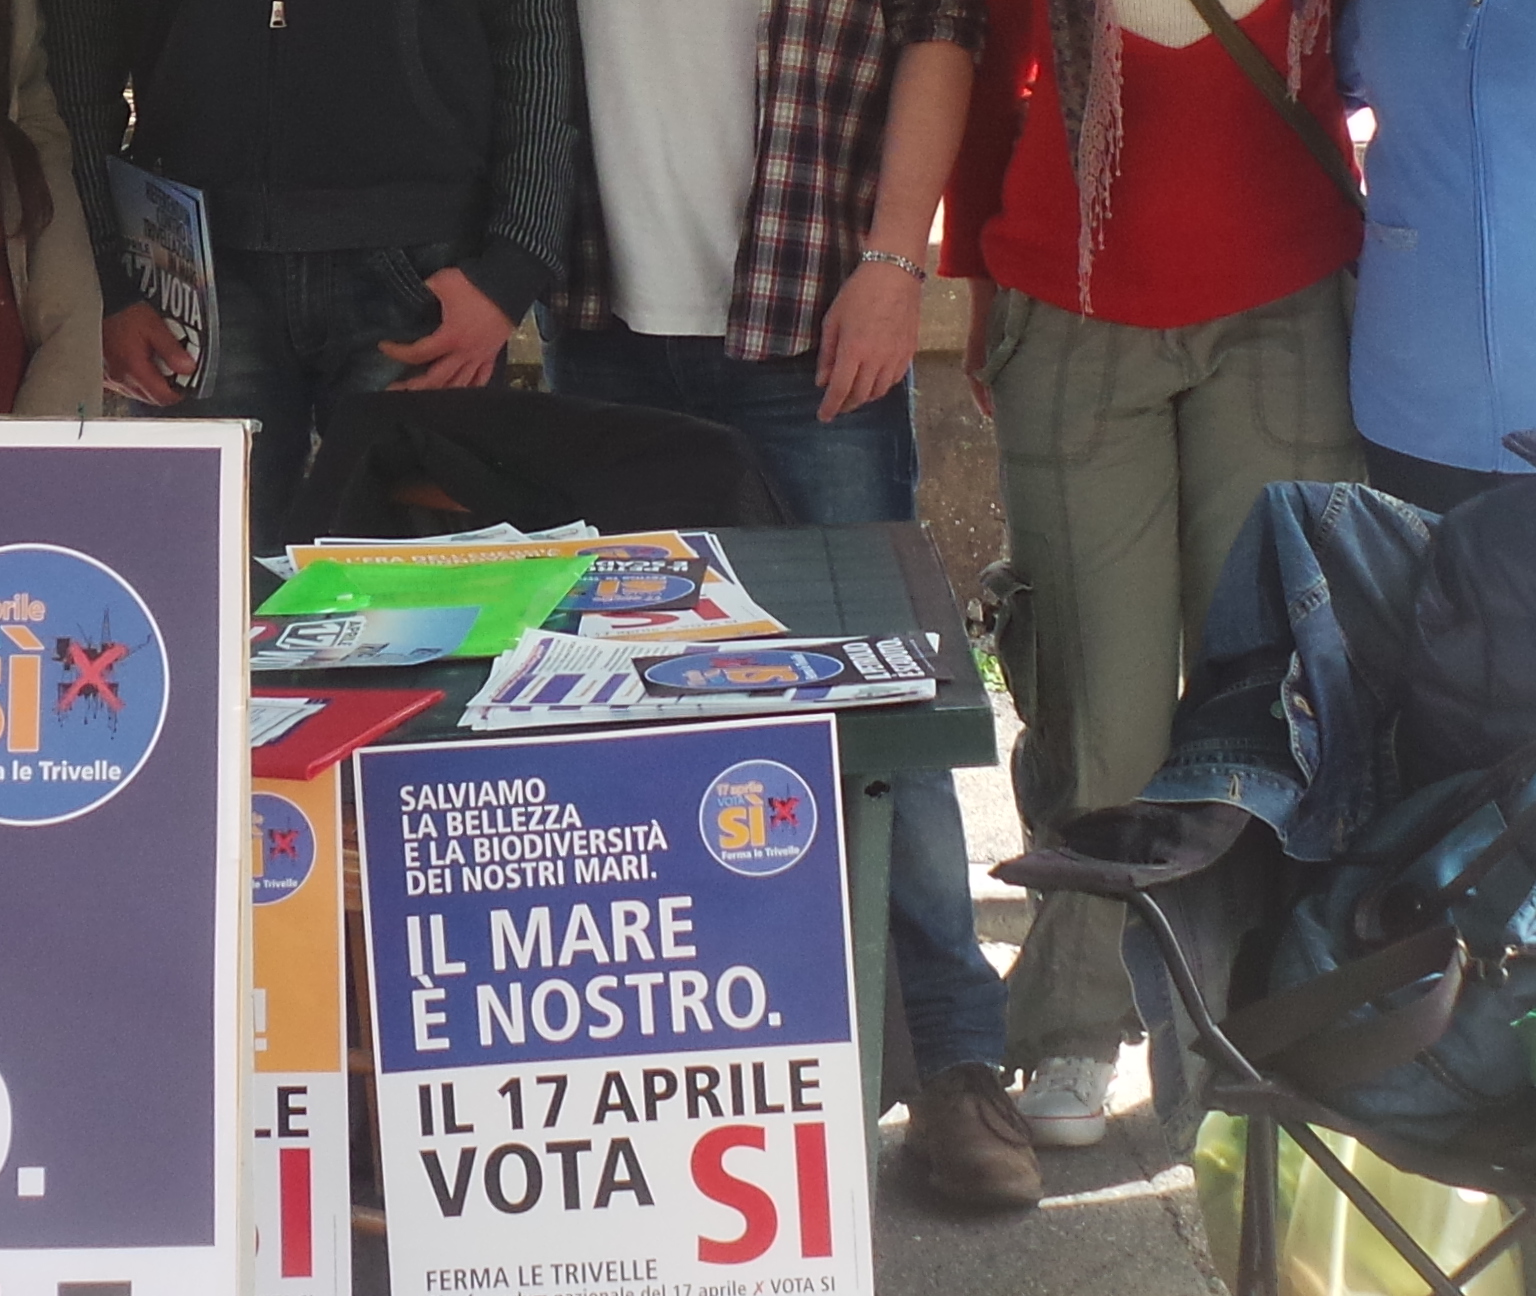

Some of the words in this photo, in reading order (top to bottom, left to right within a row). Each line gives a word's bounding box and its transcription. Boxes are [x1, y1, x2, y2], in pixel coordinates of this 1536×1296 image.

[161, 269, 203, 331] VOTA
[13, 761, 31, 781] le
[39, 761, 121, 781] Trivelle
[400, 777, 546, 811] SALVIAMO
[402, 814, 437, 840] LA
[447, 804, 581, 836] BELLEZZA
[718, 793, 766, 849] SÌ
[405, 843, 420, 867] E
[430, 841, 465, 866] LA
[474, 820, 667, 862] BIODIVERSITÀ
[721, 849, 752, 861] Ferma
[754, 848, 763, 858] le
[764, 845, 800, 857] Trivelle
[406, 869, 451, 895] DEI
[464, 862, 564, 892] NOSTRI
[575, 857, 657, 884] MARI.
[407, 914, 466, 976] IL
[491, 896, 696, 971] MARE
[411, 975, 449, 1050] È
[477, 965, 781, 1046] NOSTRO.
[418, 1082, 474, 1136] IL
[497, 1075, 568, 1130] 17
[593, 1058, 823, 1125] APRILE
[419, 1137, 655, 1218] VOTA
[690, 1122, 833, 1265] SI
[426, 1266, 510, 1292] FERMA
[518, 1264, 544, 1287] LE
[550, 1259, 658, 1285] TRIVELLE
[770, 1277, 815, 1294] VOTA
[821, 1276, 835, 1292] SI
